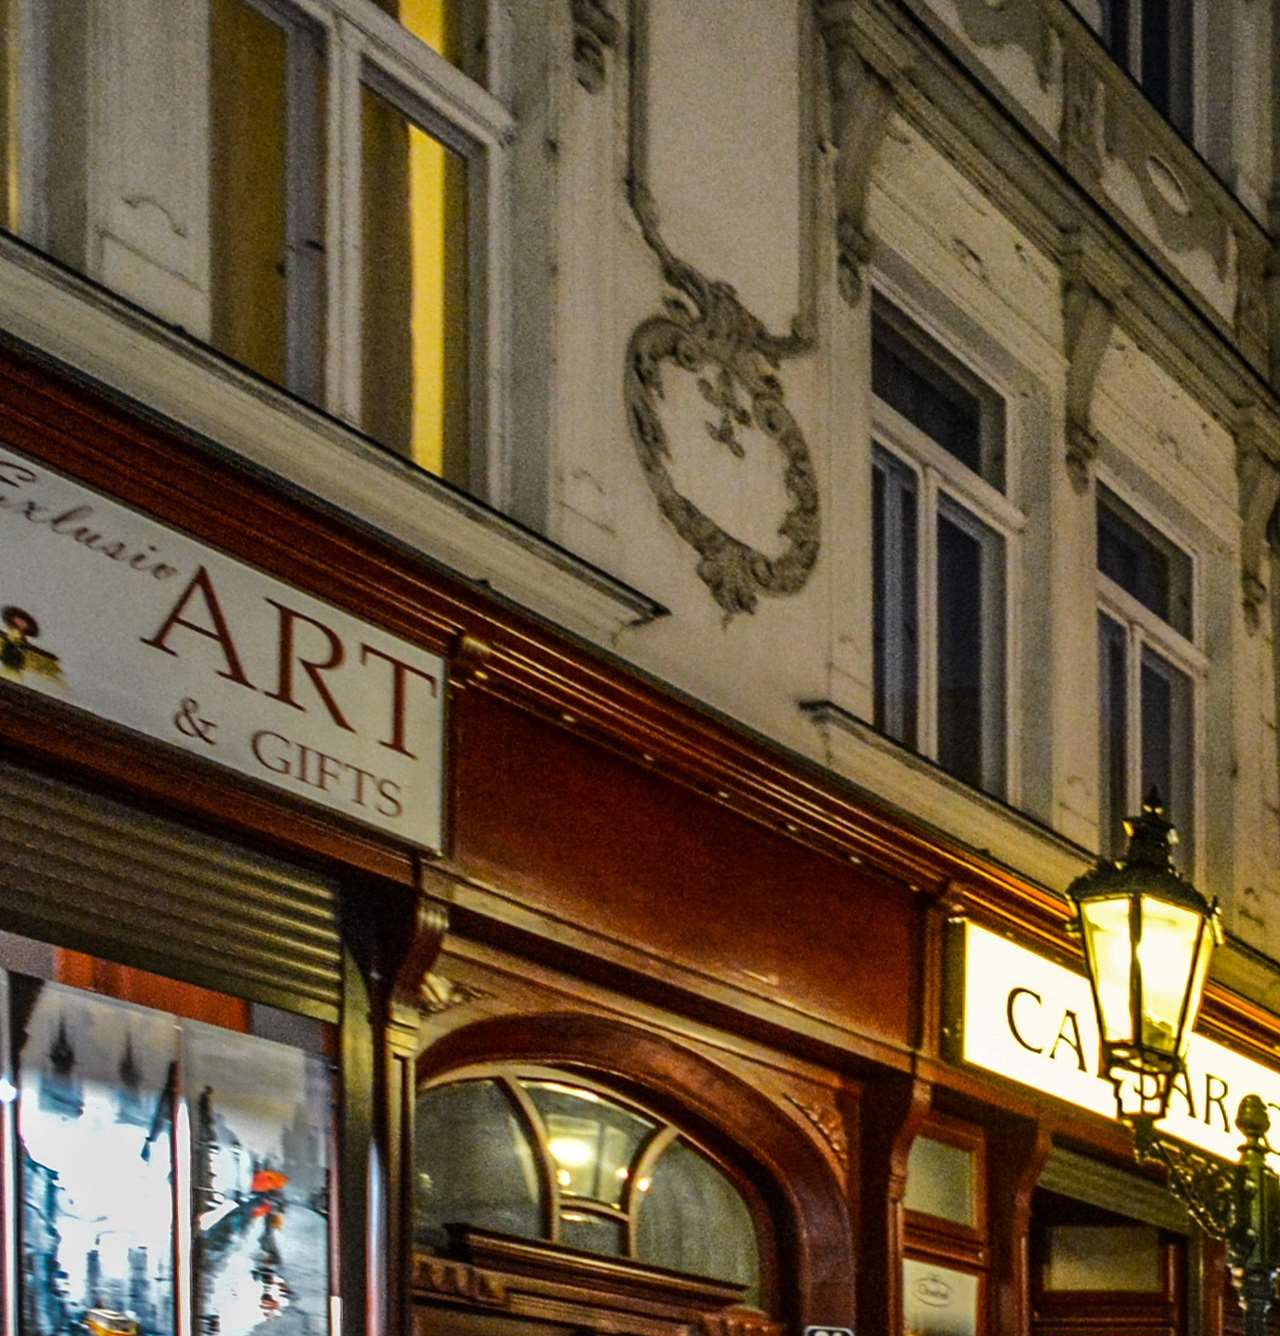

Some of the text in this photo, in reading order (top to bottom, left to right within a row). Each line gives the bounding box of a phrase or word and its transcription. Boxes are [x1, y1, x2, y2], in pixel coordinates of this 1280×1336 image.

[139, 565, 438, 761] ART
[174, 696, 404, 819] & GIFTS
